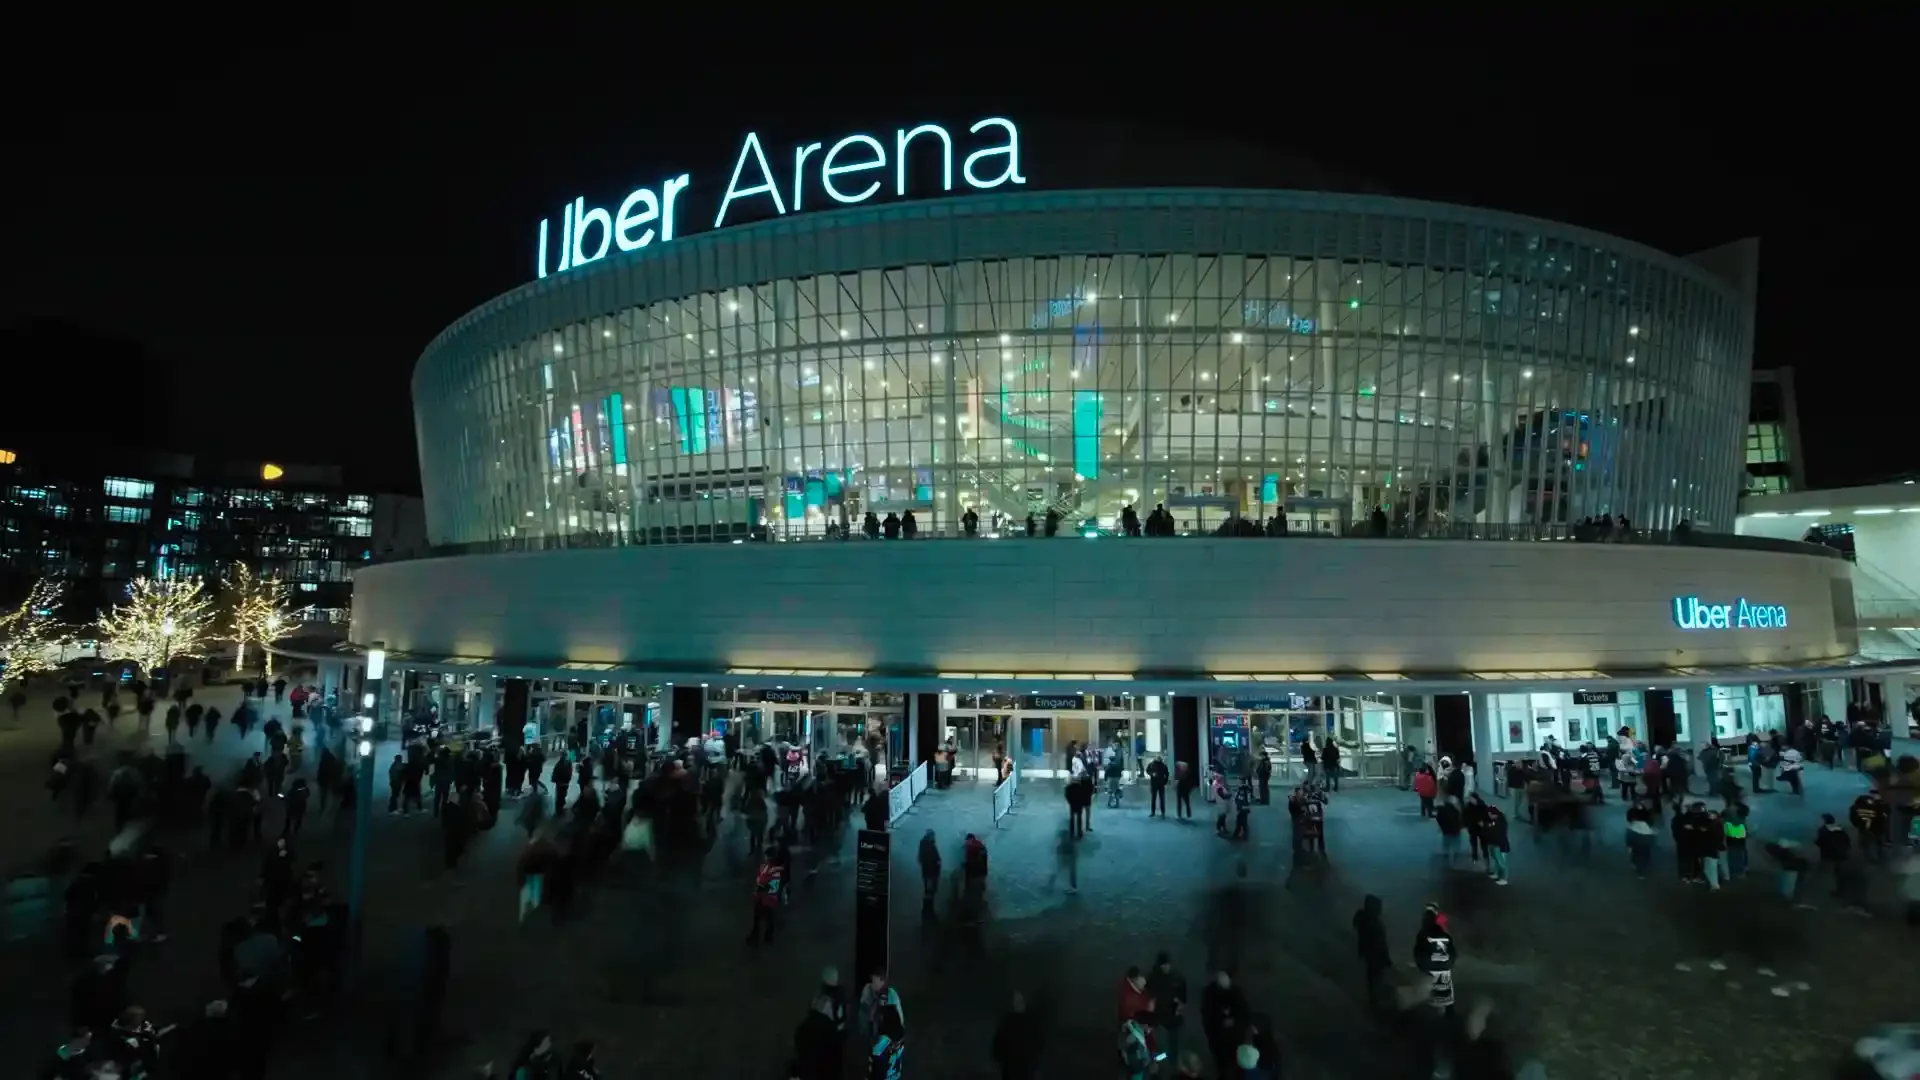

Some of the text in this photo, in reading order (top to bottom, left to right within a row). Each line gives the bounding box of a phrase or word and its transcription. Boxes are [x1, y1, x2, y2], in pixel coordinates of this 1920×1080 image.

[537, 116, 1027, 279] Uber Arena
[1674, 596, 1788, 629] Uber Arena
[766, 690, 802, 702] Eingang
[1581, 693, 1609, 702] Tickets
[1035, 697, 1077, 709] Eingang
